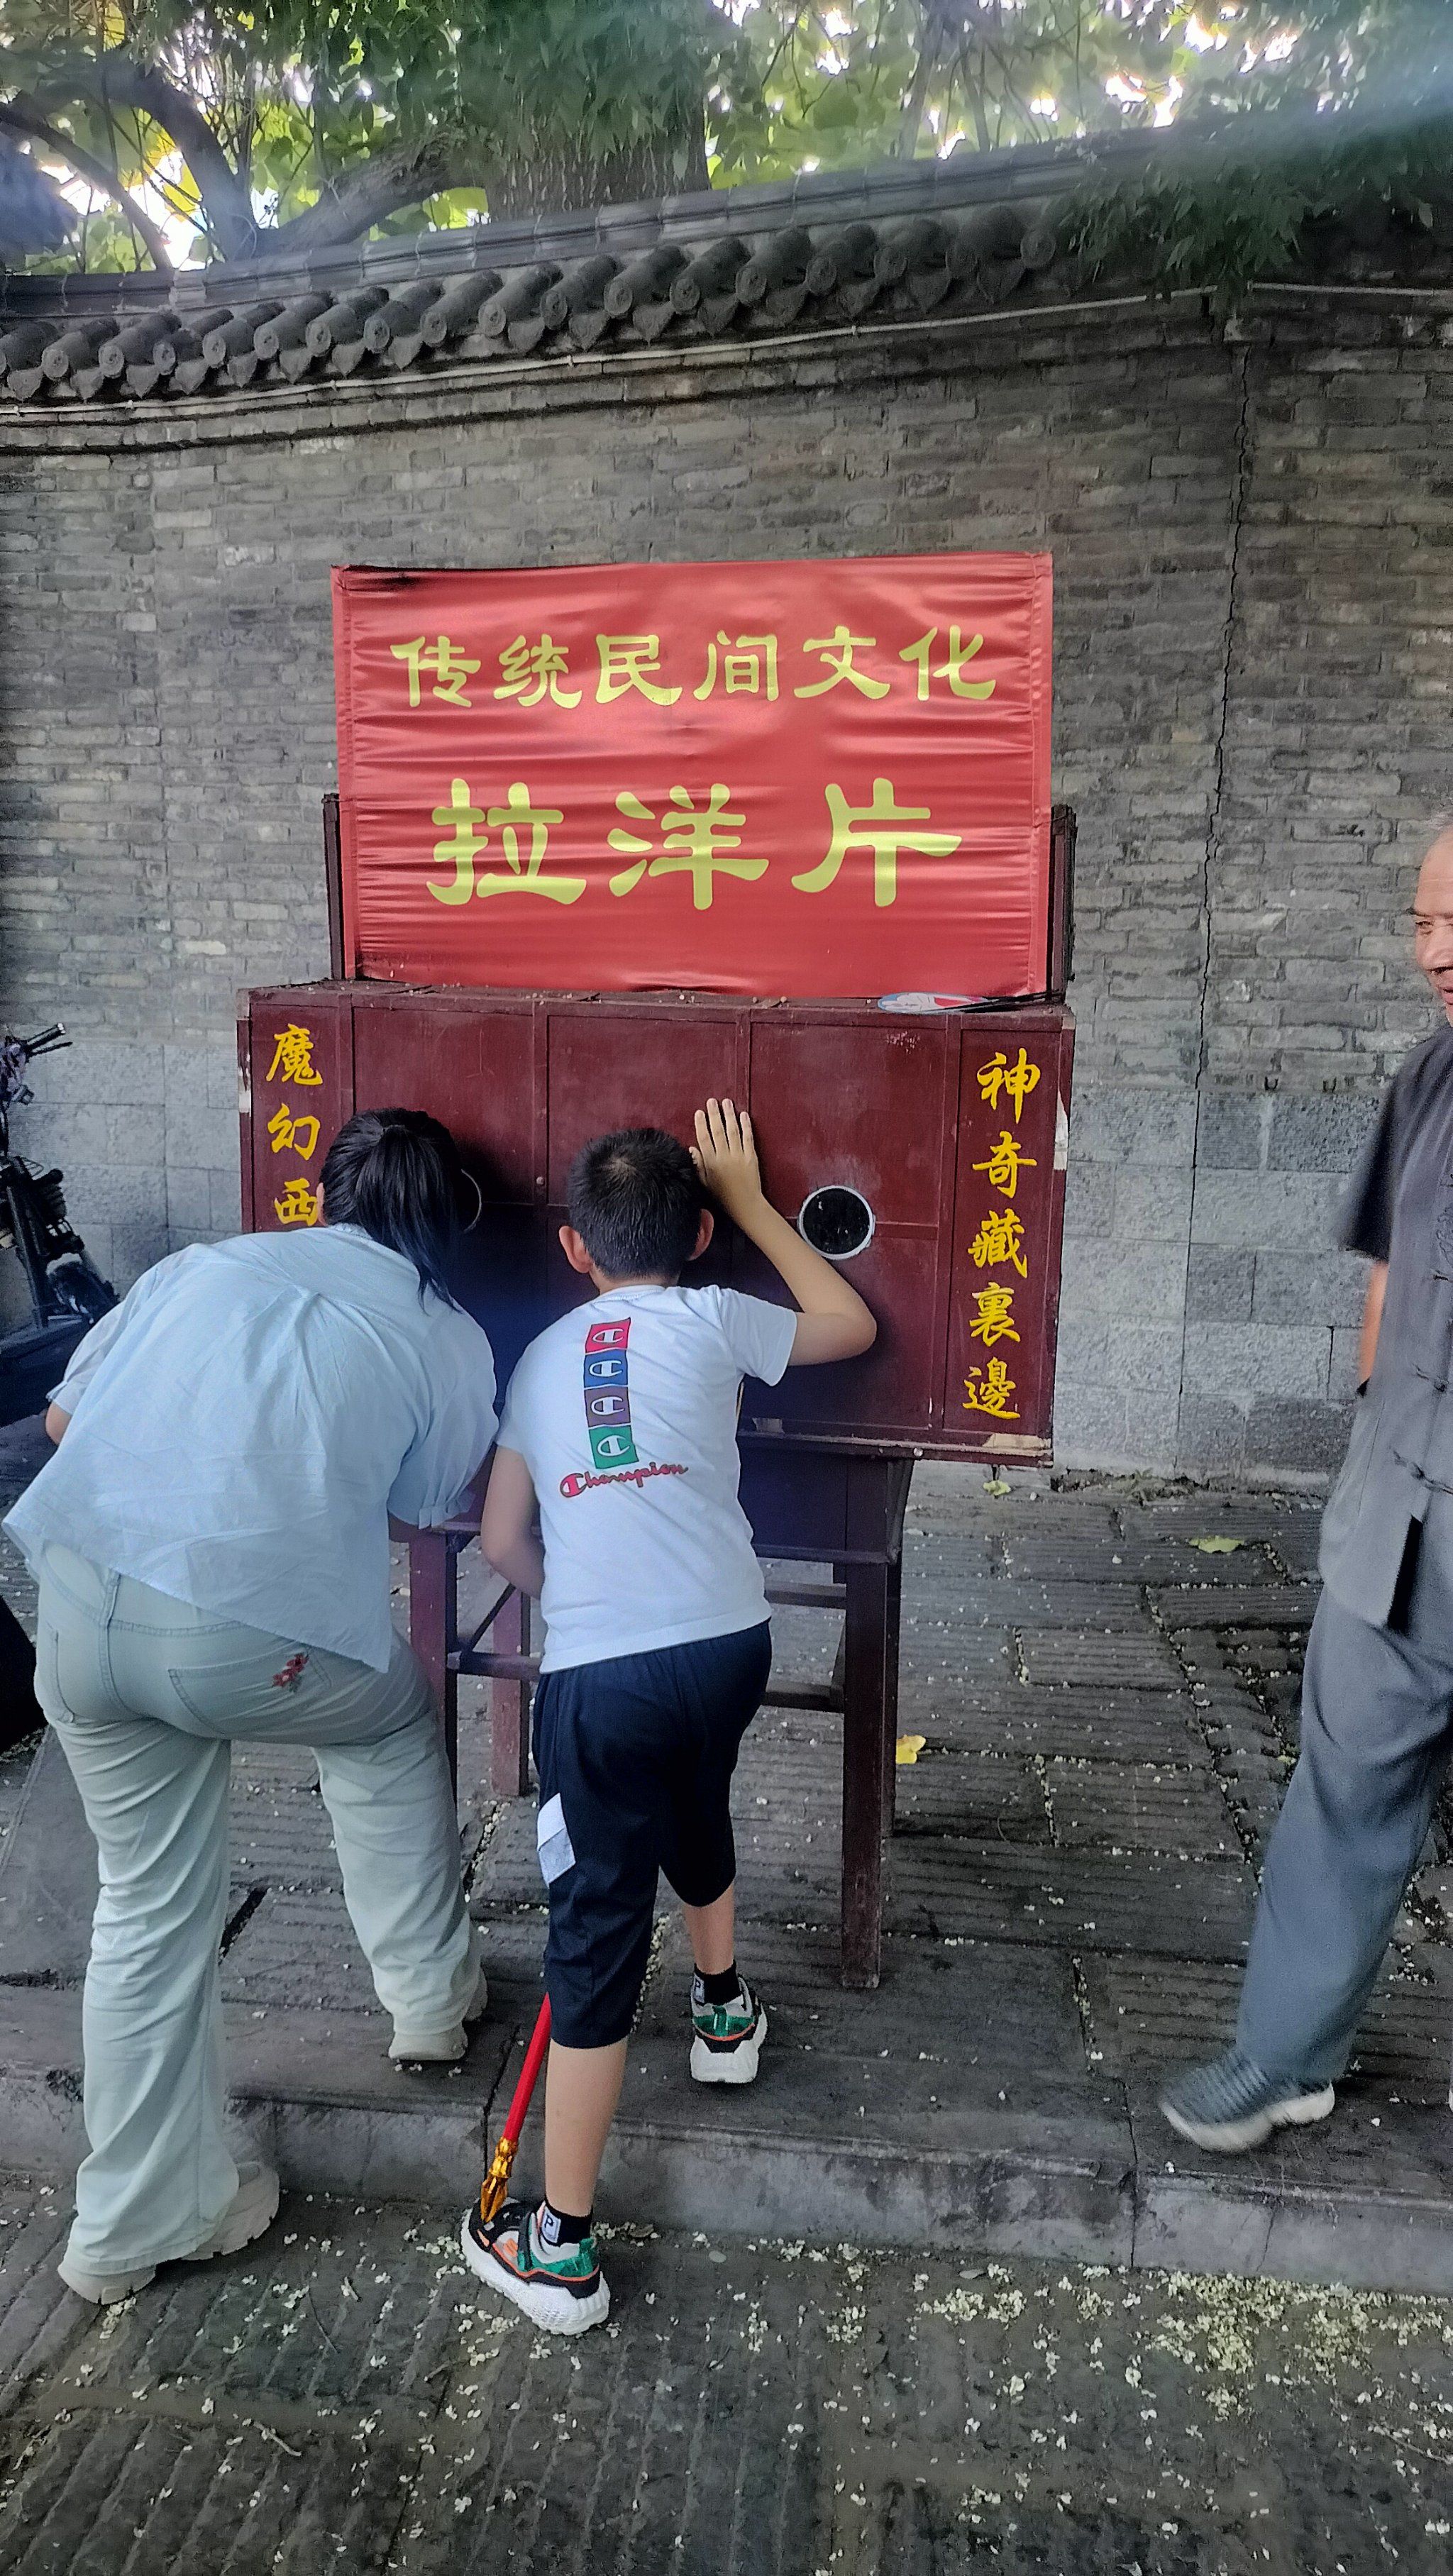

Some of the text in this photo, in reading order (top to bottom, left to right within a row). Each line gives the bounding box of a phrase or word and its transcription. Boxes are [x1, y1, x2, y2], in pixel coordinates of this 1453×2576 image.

[390, 624, 997, 709] 传统民间文化
[426, 778, 962, 911] 拉洋片
[266, 1023, 323, 1227] 魔幻西
[962, 1047, 1041, 1420] 神奇藏裏邊
[560, 1461, 689, 1498] Champion
